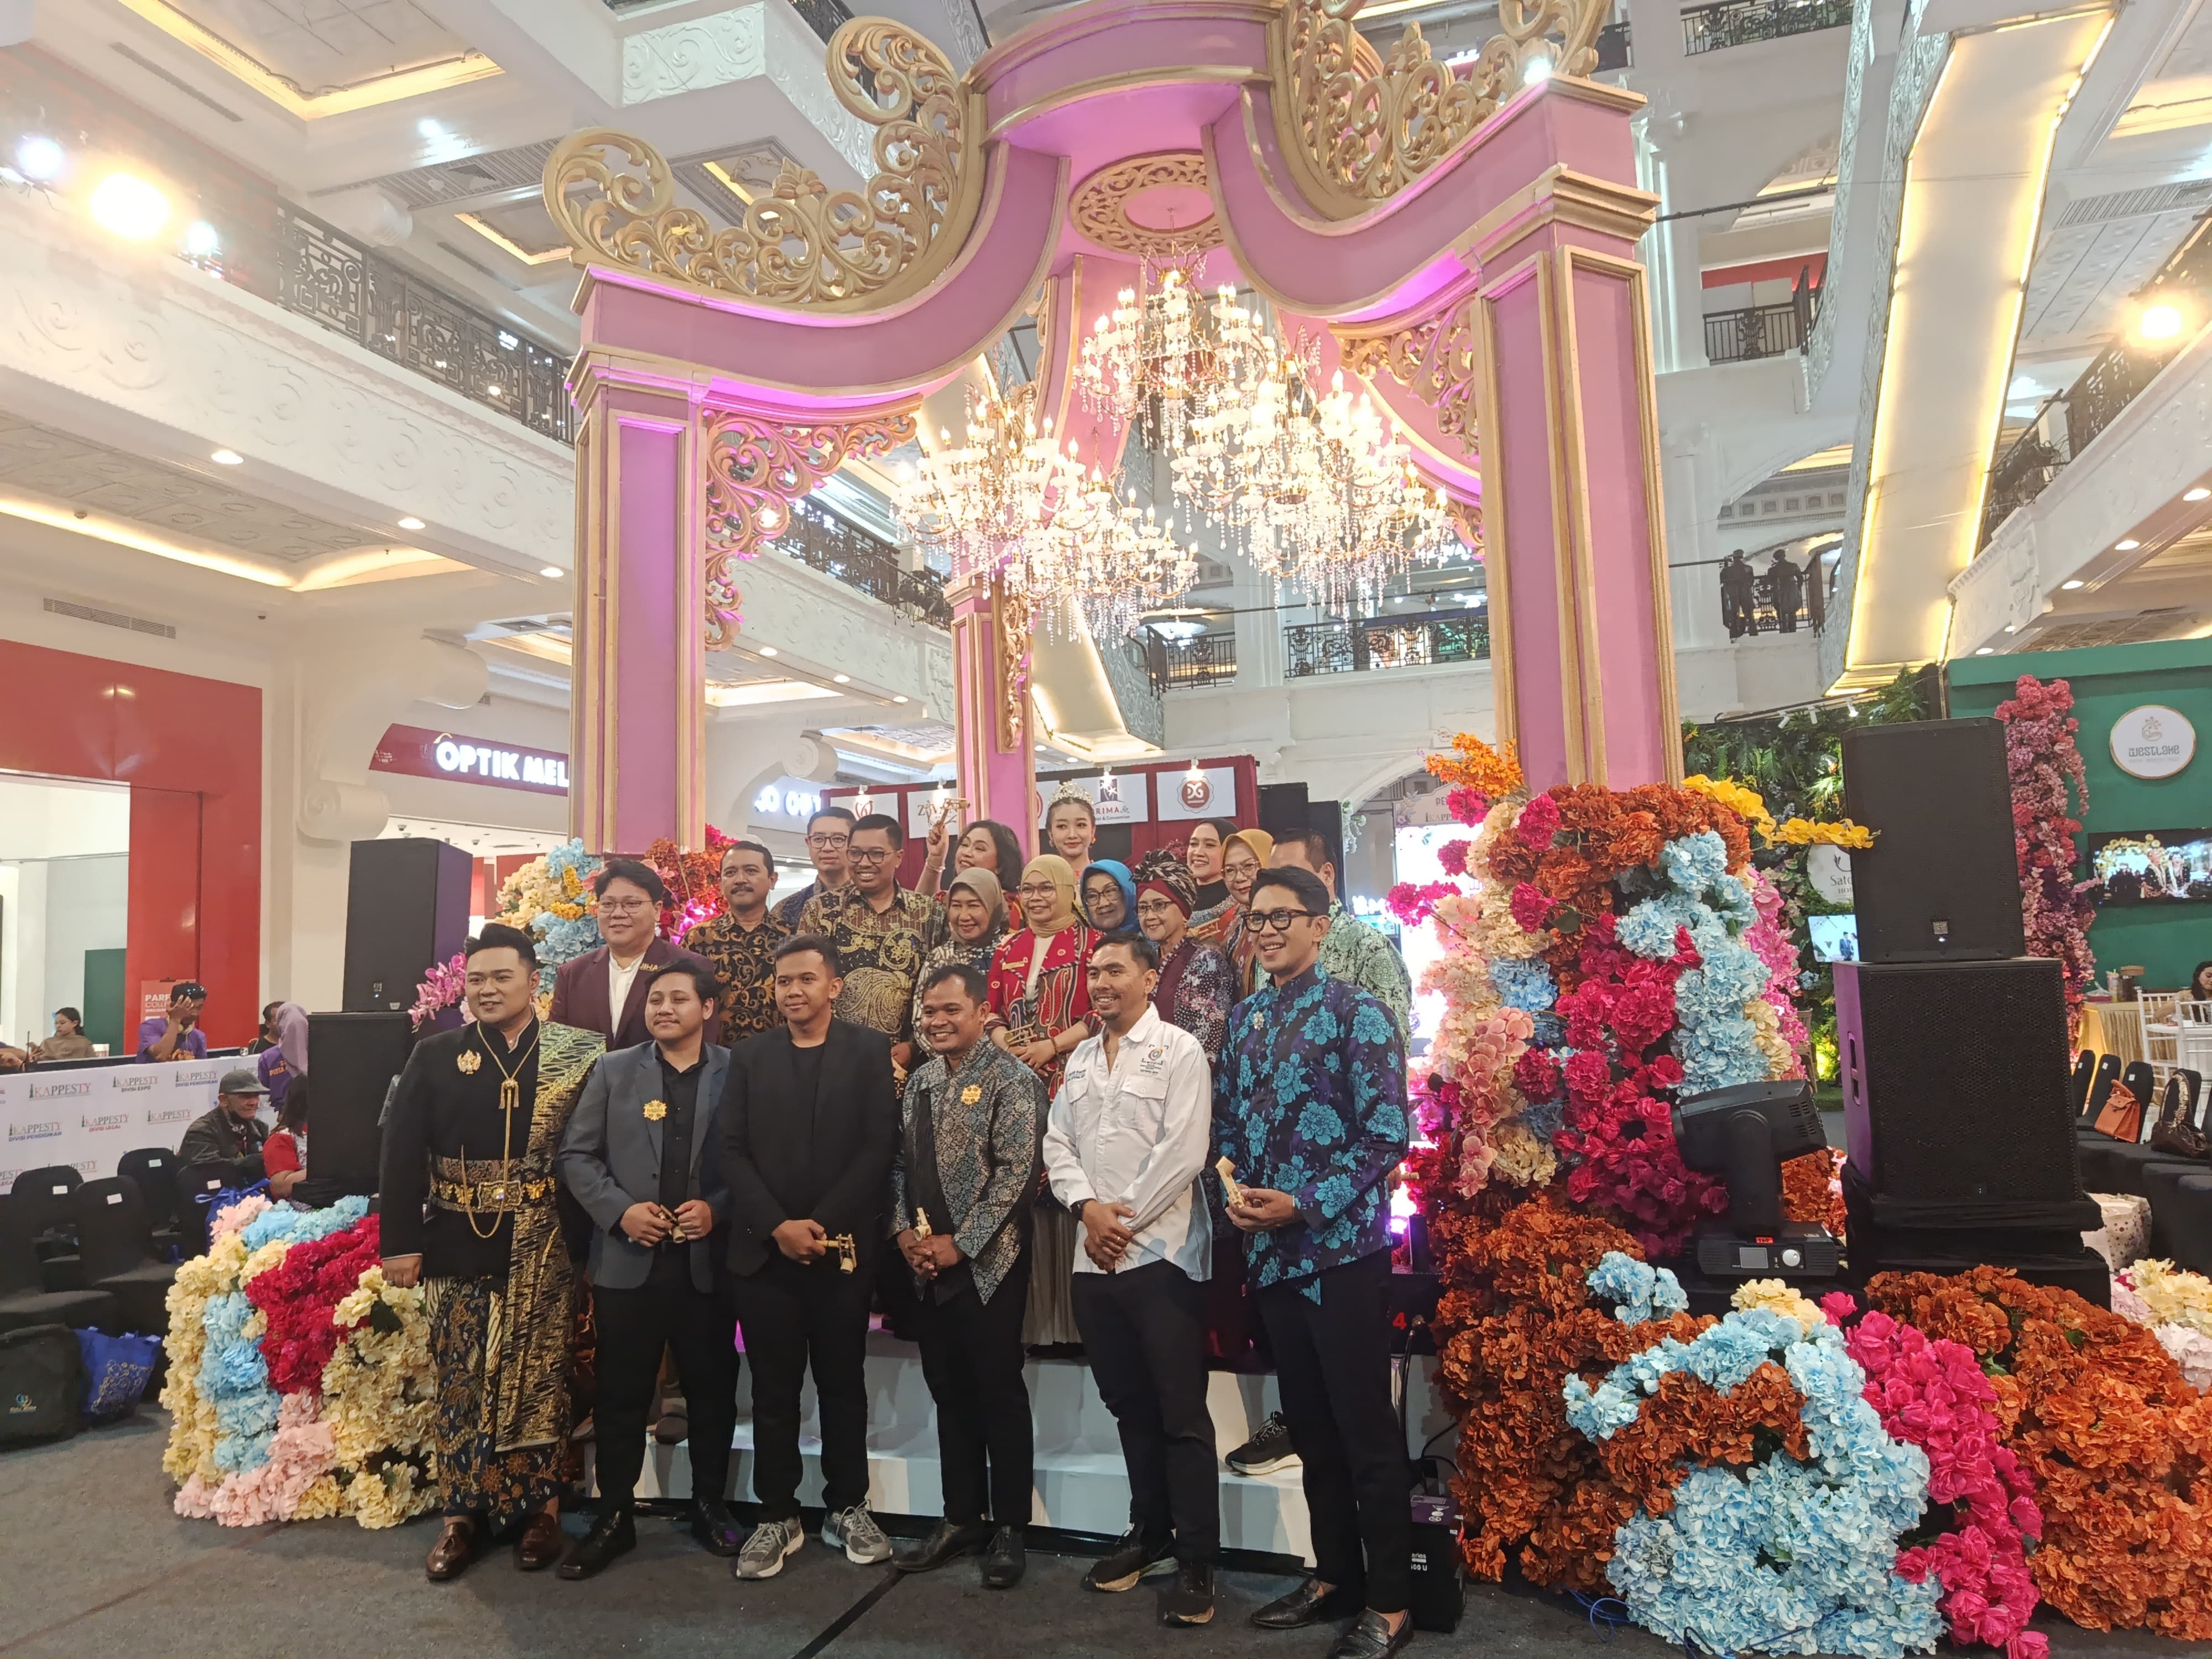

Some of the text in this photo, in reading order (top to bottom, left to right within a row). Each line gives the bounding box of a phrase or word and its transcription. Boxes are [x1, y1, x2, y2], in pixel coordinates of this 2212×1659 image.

[436, 740, 570, 788] OPTIK MEL
[1095, 806, 1119, 815] RIMA
[1392, 1311, 1407, 1330] 4
